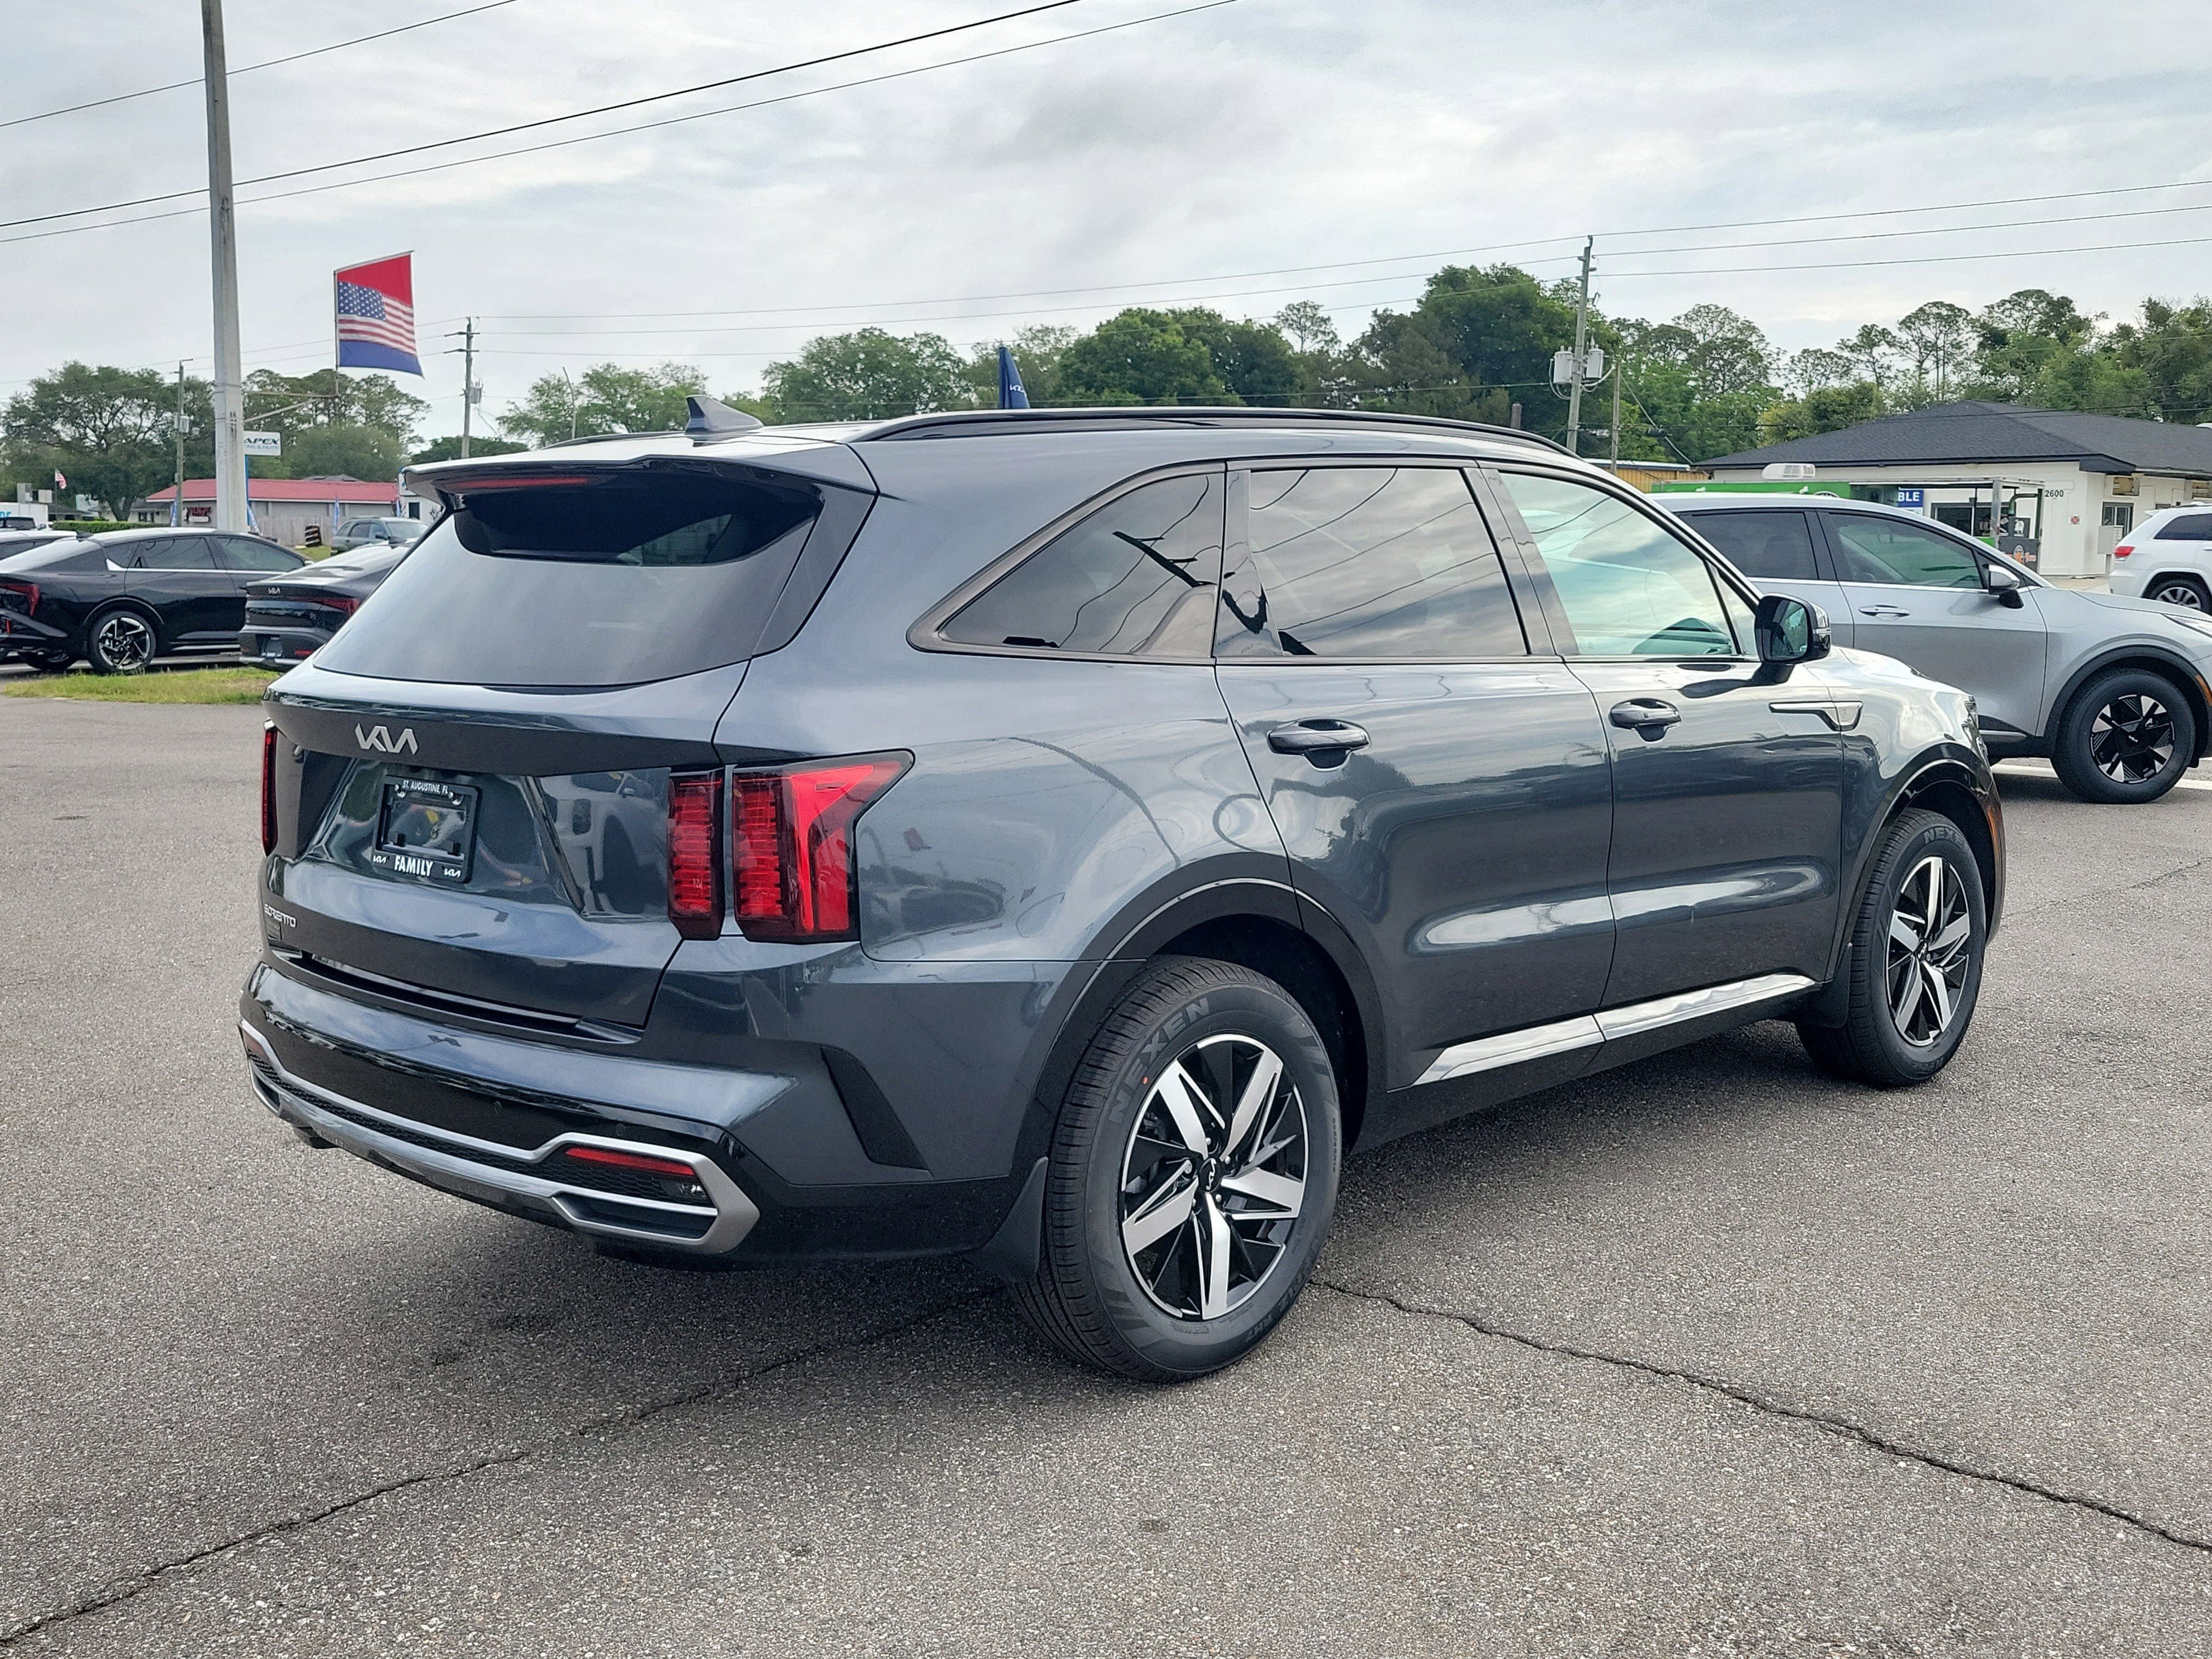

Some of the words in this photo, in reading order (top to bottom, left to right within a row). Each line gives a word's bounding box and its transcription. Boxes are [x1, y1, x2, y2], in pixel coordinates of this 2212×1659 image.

[2045, 489, 2064, 498] 2600
[355, 723, 419, 755] KIA
[410, 781, 441, 794] AUGUSTINE,
[442, 785, 448, 794] FL
[373, 855, 387, 864] KIA
[394, 855, 433, 877] FAMILY
[444, 868, 461, 878] KIA
[1109, 997, 1210, 1124] NEXEN
